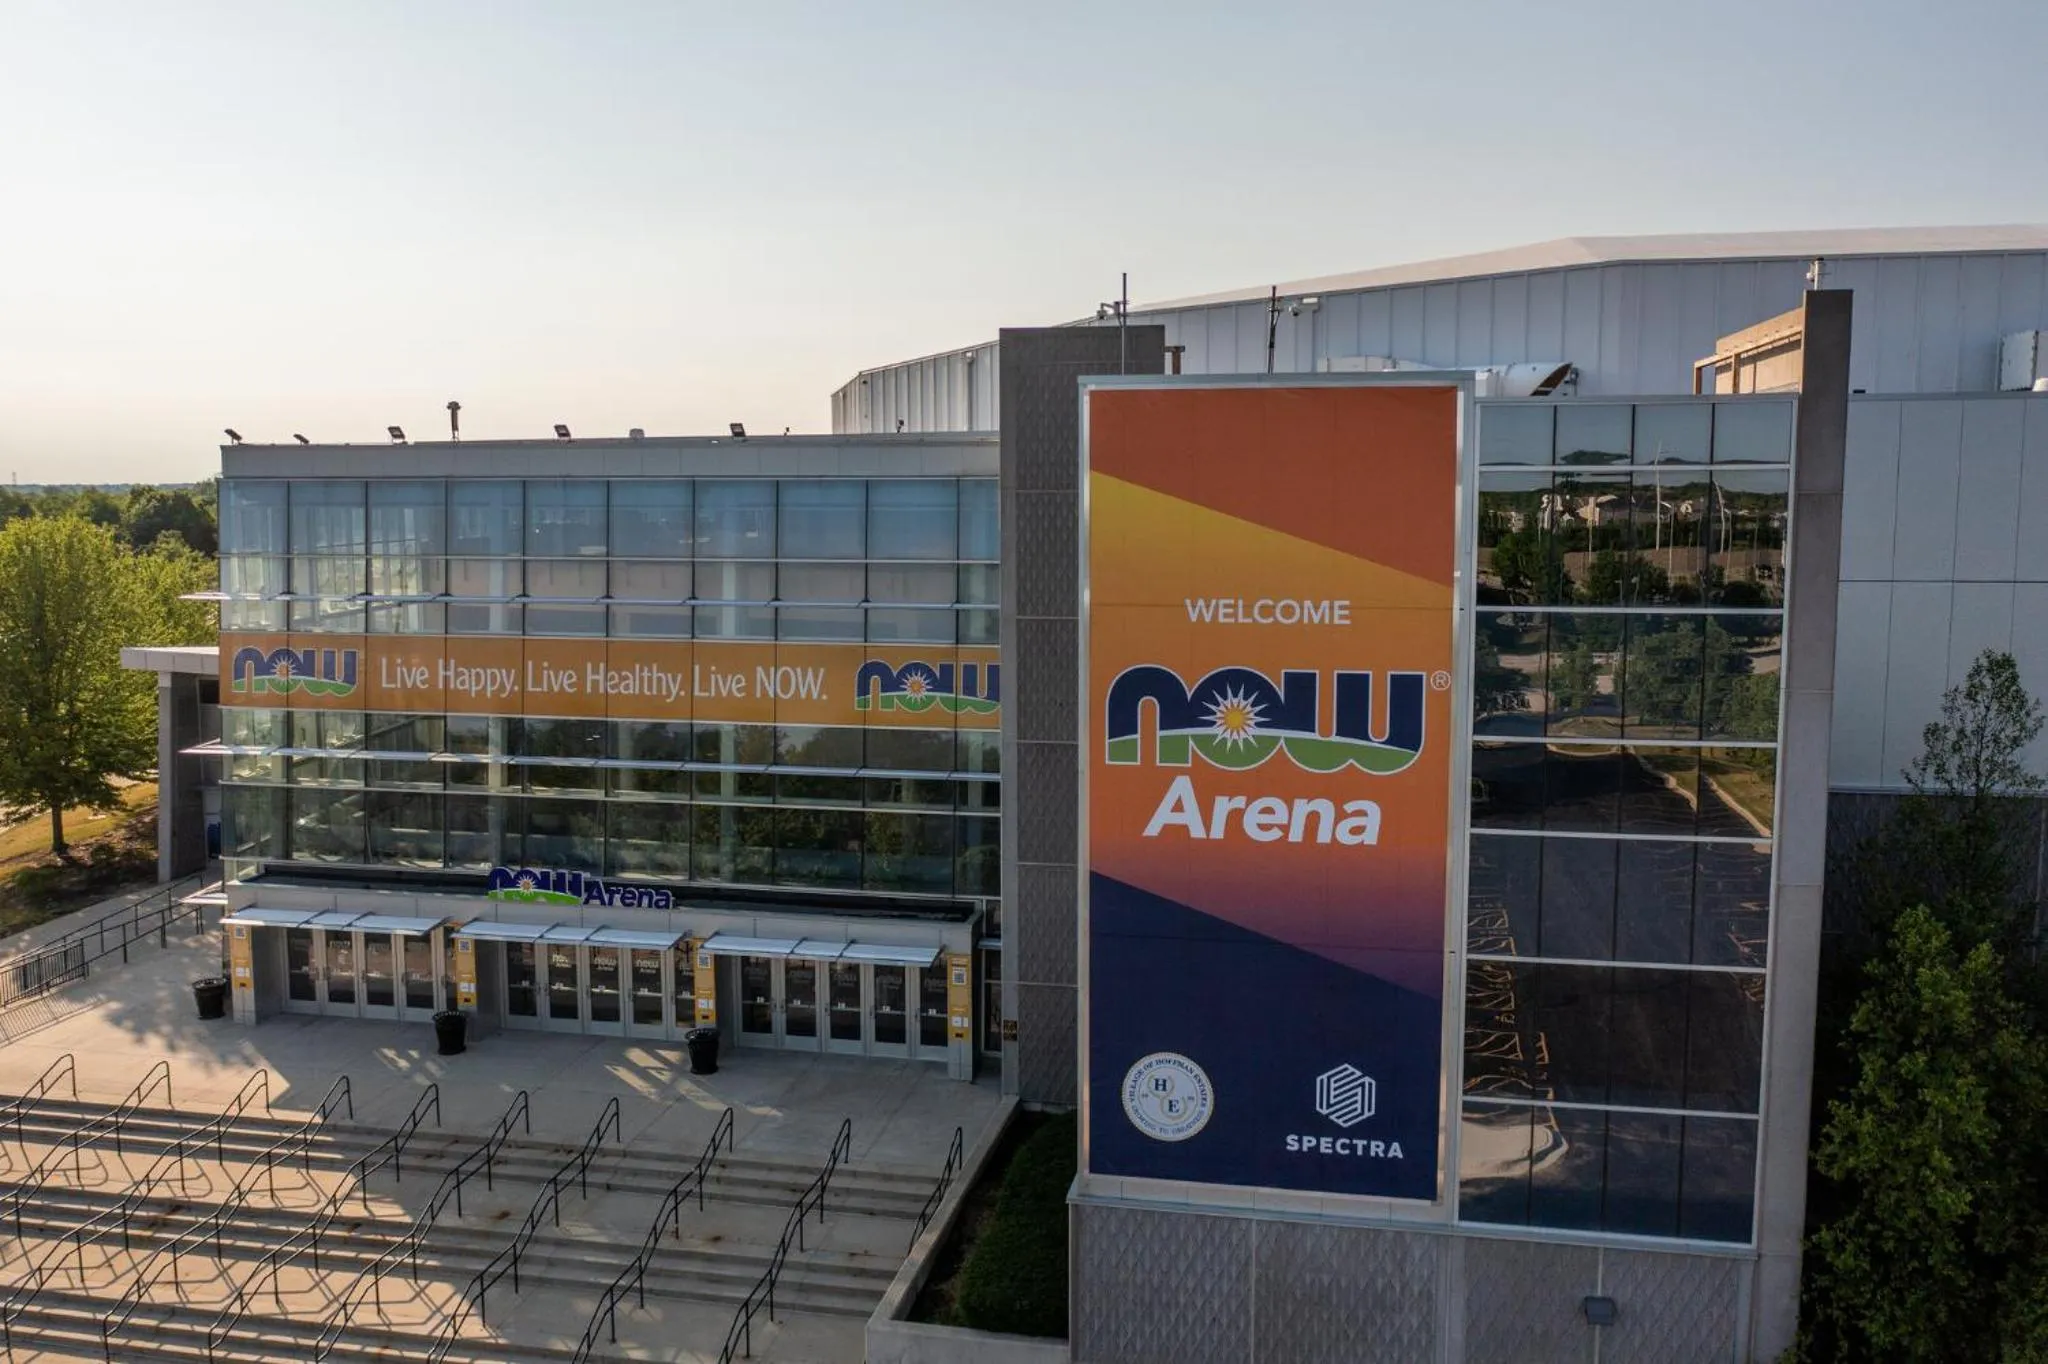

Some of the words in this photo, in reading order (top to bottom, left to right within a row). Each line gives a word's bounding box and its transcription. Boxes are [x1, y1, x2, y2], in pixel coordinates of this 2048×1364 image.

[1184, 598, 1351, 625] WELCOME
[381, 657, 429, 690] Live
[437, 658, 520, 699] Happy.
[527, 660, 578, 694] Live
[586, 661, 686, 703] Healthy.
[693, 664, 746, 699] Live
[755, 665, 829, 701] NOW.
[1105, 663, 1427, 776] now
[1142, 775, 1382, 846] Arena
[583, 879, 675, 910] Arena
[1154, 1078, 1168, 1092] H
[1168, 1099, 1180, 1114] E
[1286, 1134, 1404, 1159] SPECTRA
